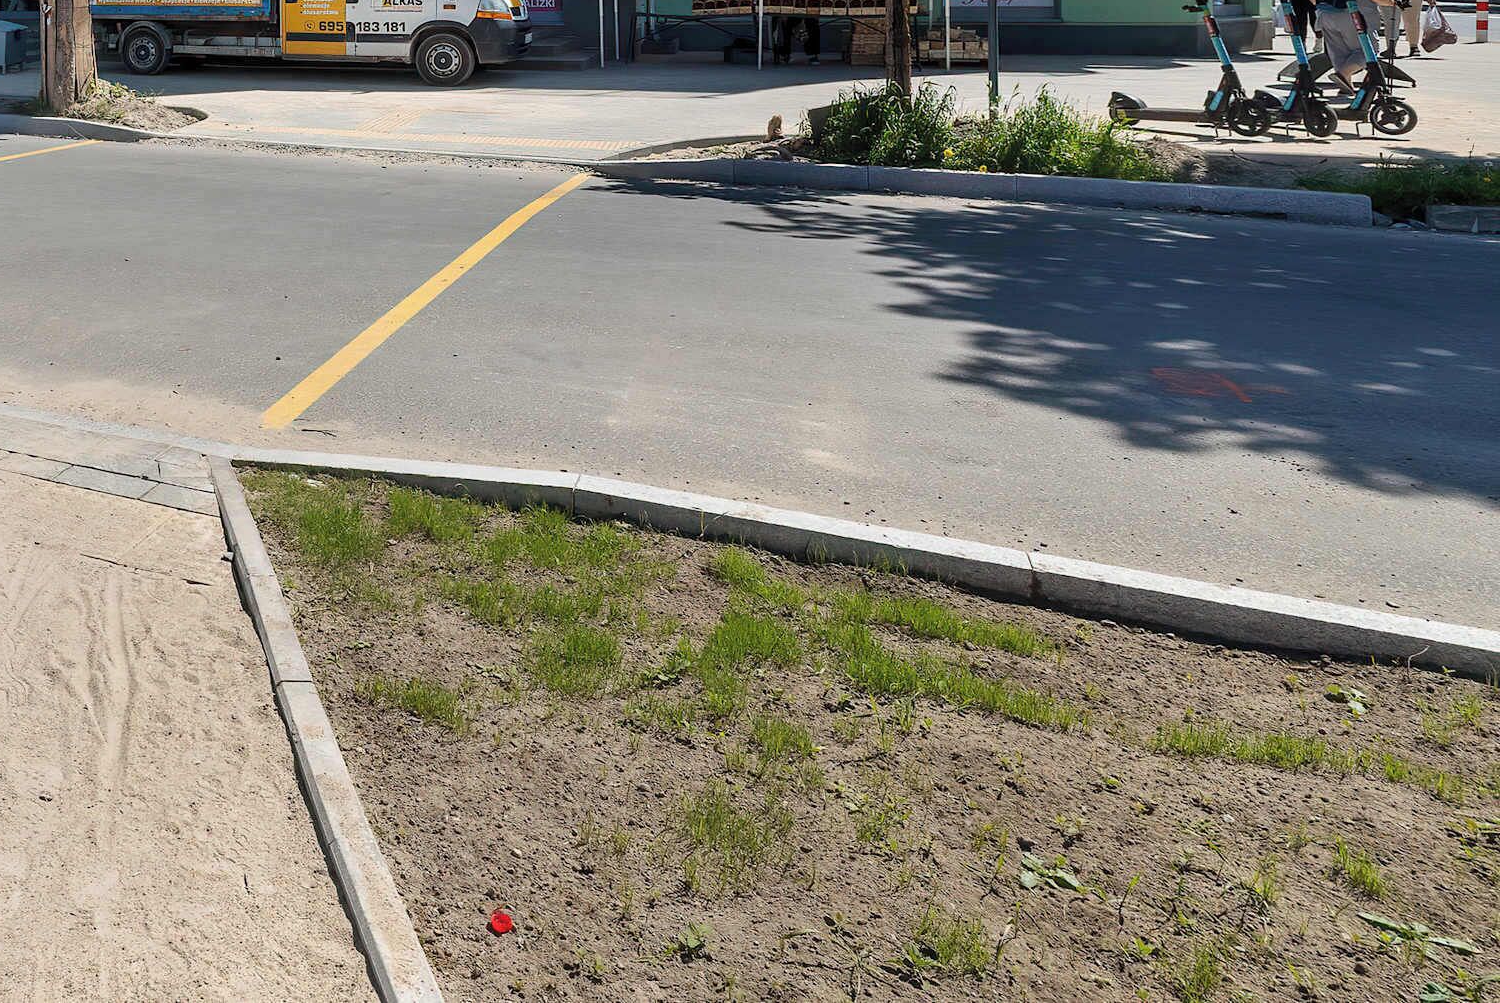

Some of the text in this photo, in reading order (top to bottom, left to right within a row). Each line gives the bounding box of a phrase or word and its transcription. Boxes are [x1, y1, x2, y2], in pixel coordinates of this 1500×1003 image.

[525, 0, 556, 8] ALIZKI
[319, 21, 406, 32] 695 183 181
